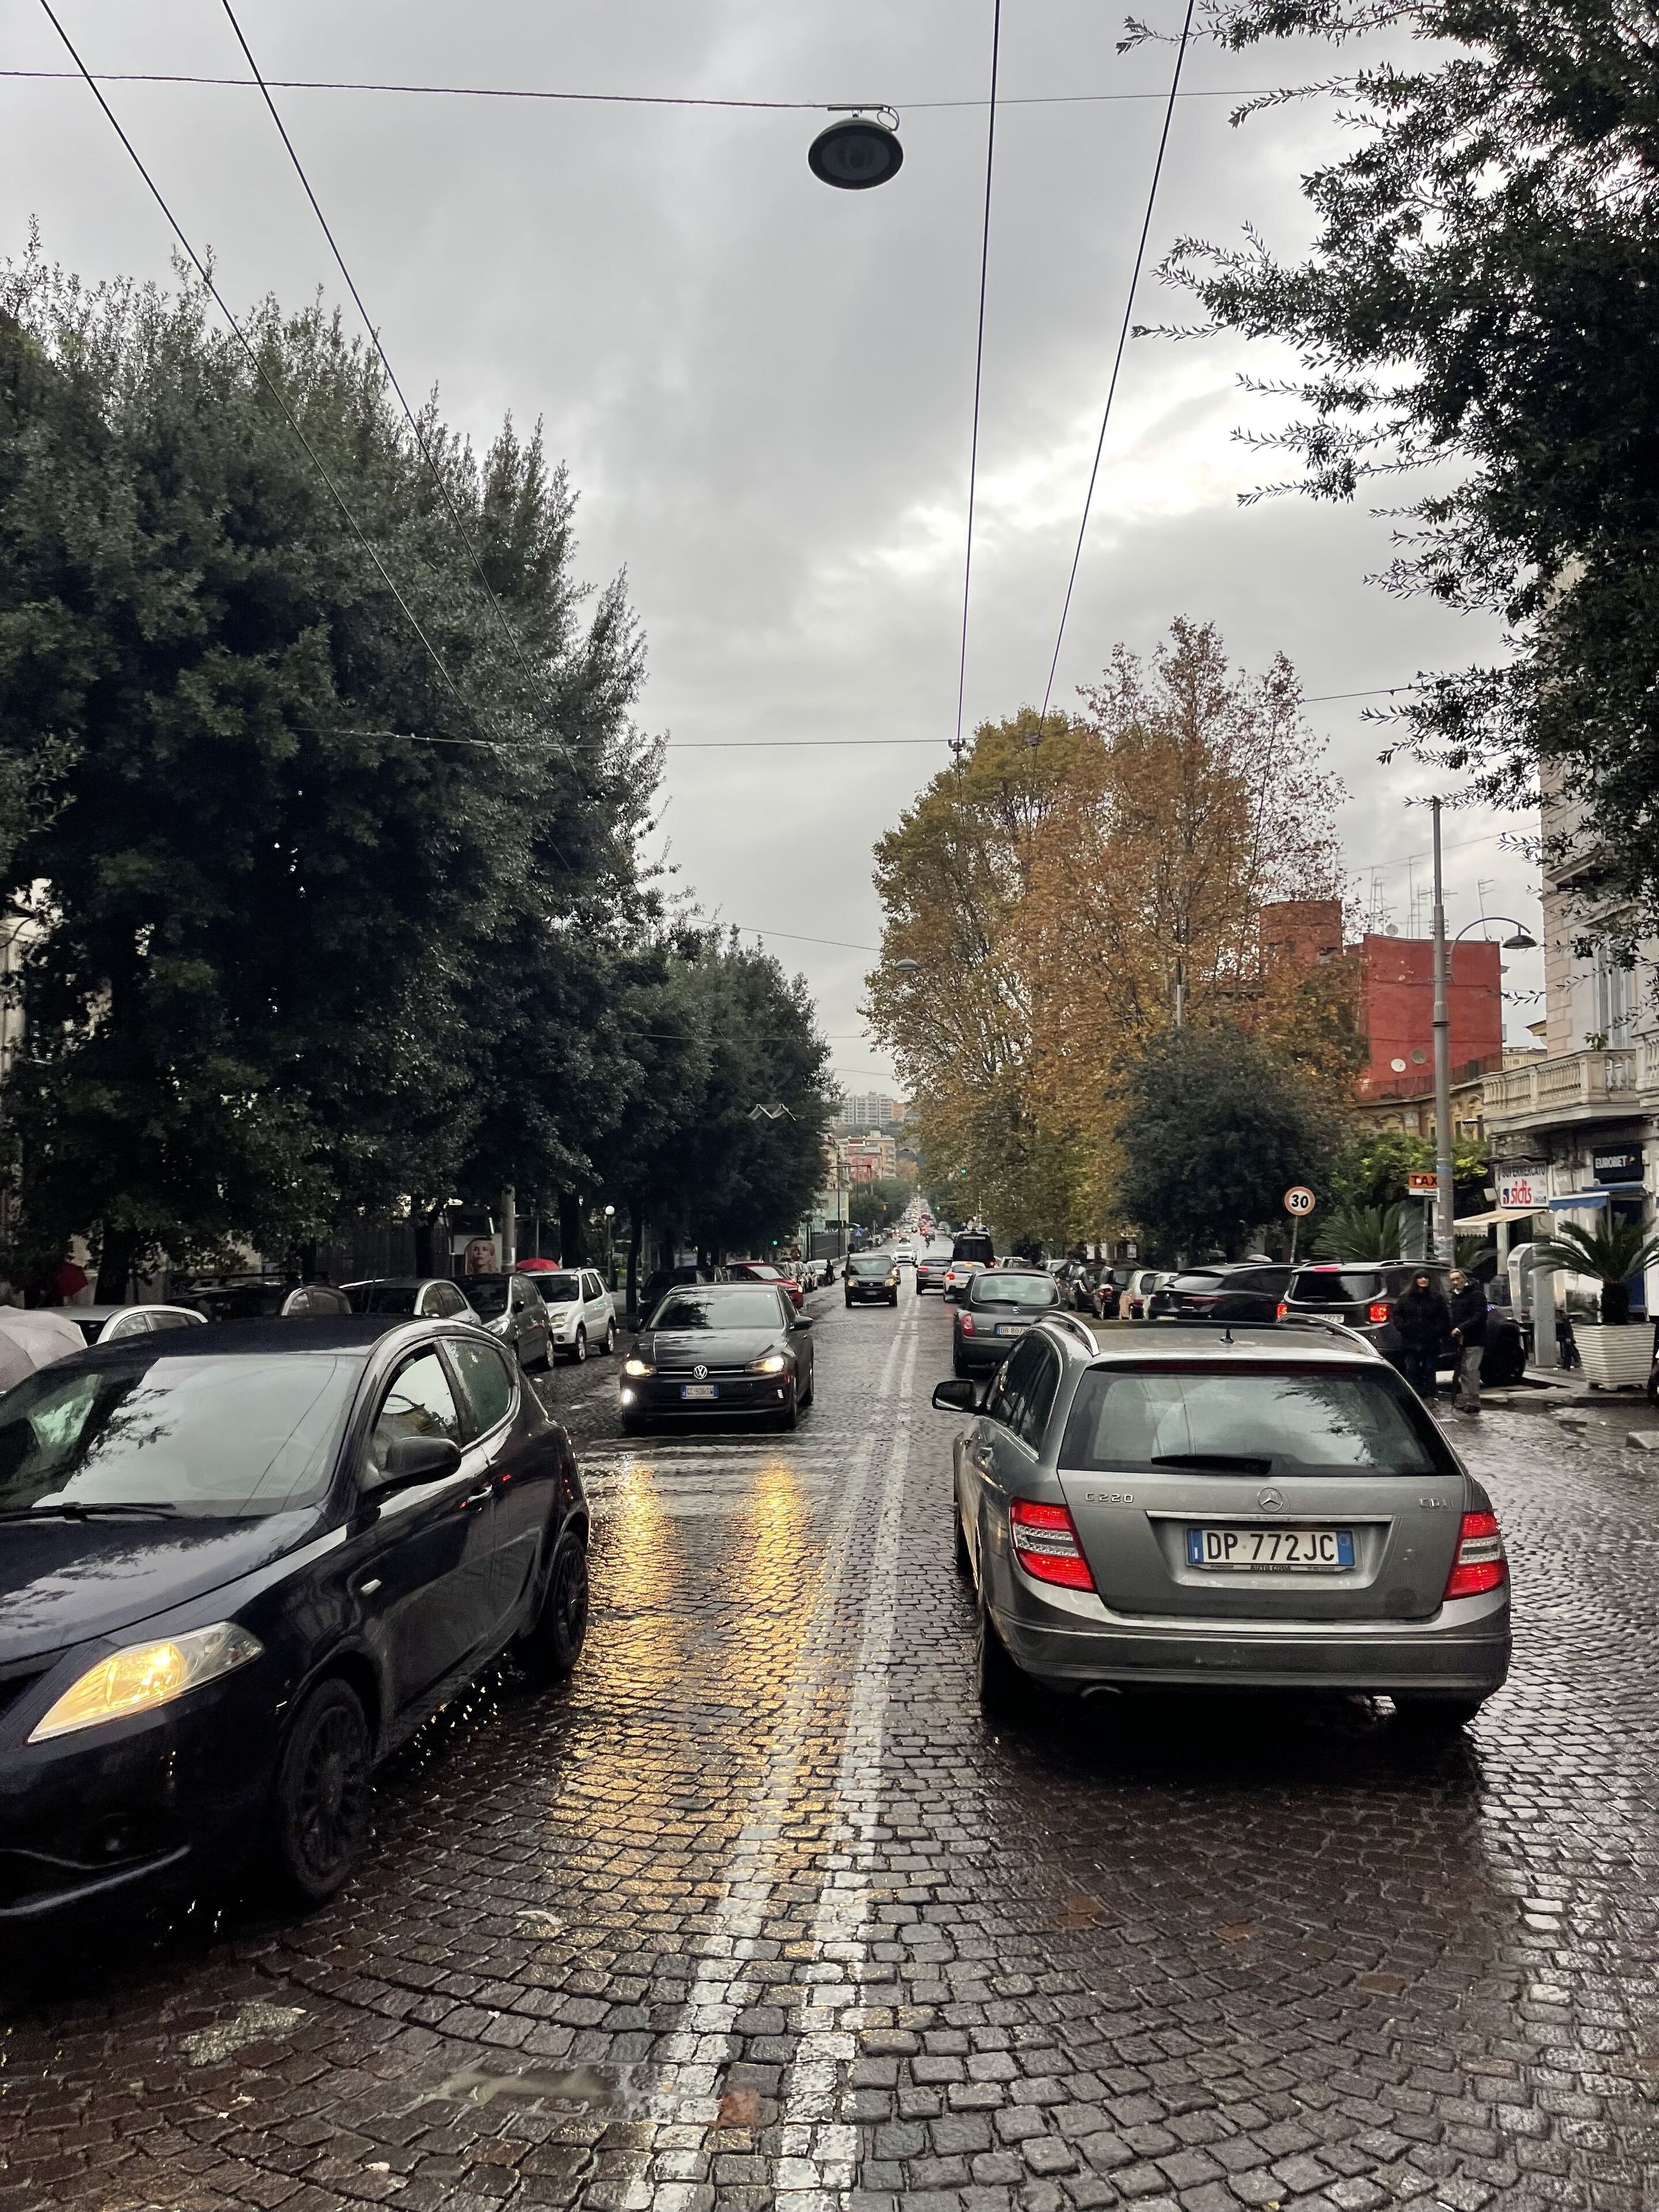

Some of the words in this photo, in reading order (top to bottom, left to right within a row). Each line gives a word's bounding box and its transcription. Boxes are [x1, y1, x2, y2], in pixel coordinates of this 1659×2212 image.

[1594, 1156, 1627, 1169] EUROBET
[1411, 1175, 1438, 1186] TAX
[1291, 1194, 1309, 1209] 30
[1206, 1533, 1238, 1559] DP
[1250, 1533, 1335, 1561] 772JC
